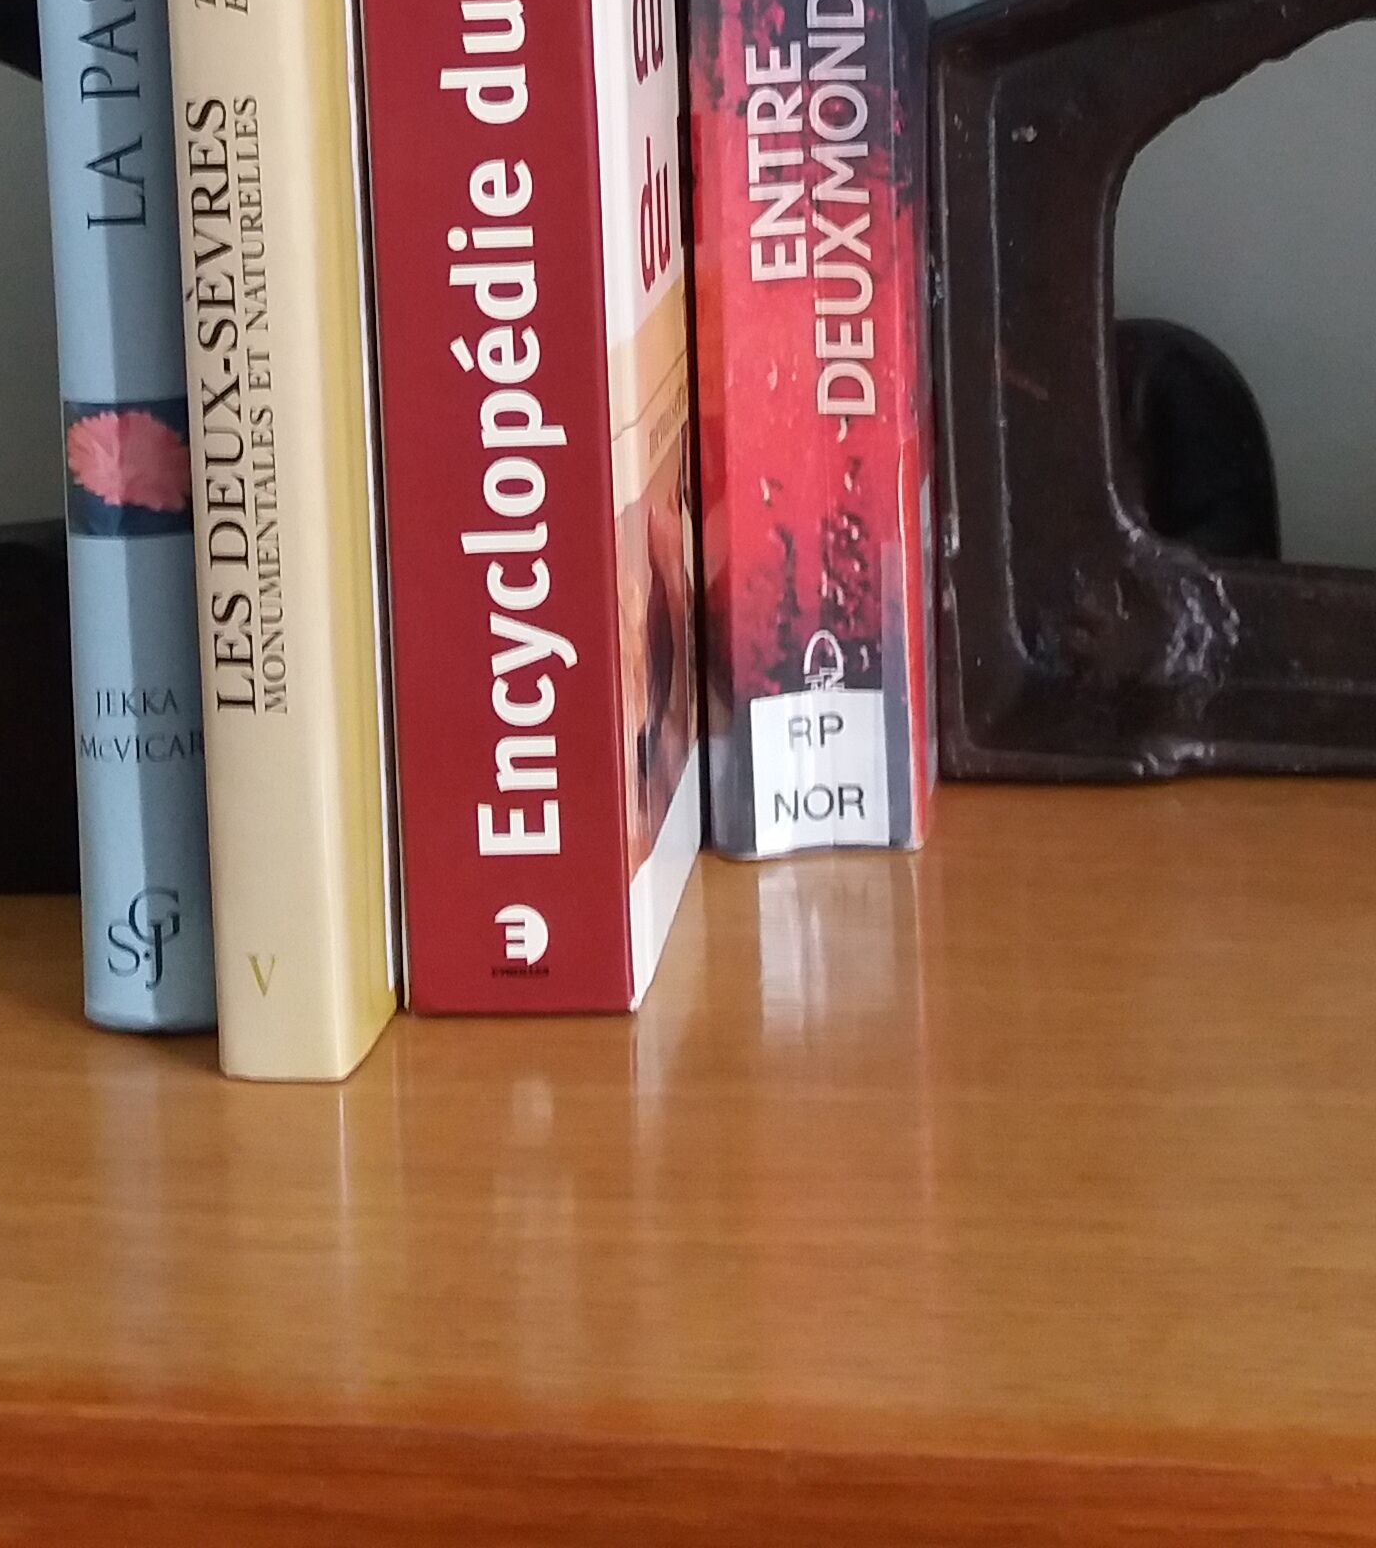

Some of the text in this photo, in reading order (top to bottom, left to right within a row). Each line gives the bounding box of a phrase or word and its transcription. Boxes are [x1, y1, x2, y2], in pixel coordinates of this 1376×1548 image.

[84, 136, 147, 231] LA
[640, 136, 671, 293] du
[745, 41, 807, 282] ENTRE
[233, 95, 288, 715] MONUMENTALES ET NATURELLES
[447, 159, 578, 857] Encyclopédie
[96, 687, 178, 719] JEKKA
[212, 592, 257, 716] LES
[788, 712, 845, 749] RP
[774, 785, 866, 824] NOR
